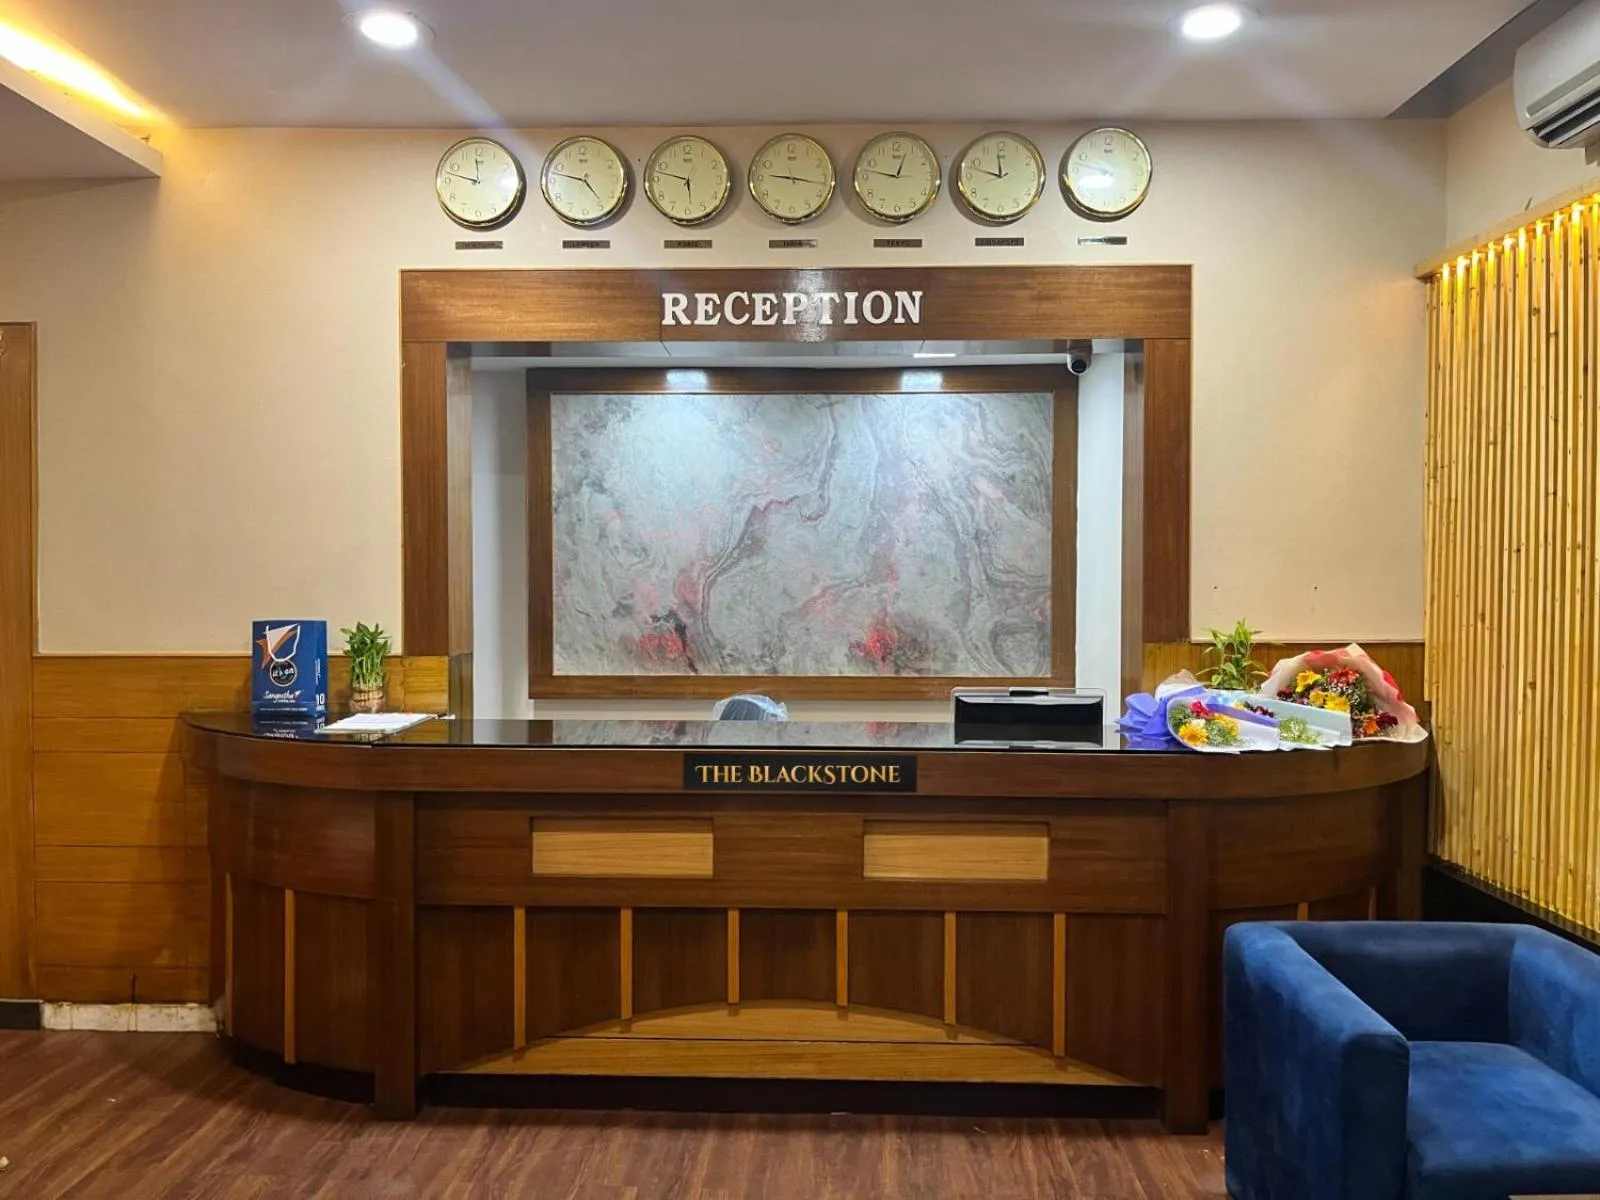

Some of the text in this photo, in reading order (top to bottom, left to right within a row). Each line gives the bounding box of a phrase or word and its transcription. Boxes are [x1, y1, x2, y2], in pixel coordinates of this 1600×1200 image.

[1105, 136, 1113, 145] 12
[578, 145, 587, 155] 12
[683, 145, 692, 155] 12
[787, 144, 795, 153] 12
[893, 142, 901, 151] 12
[997, 141, 1005, 151] 12
[475, 147, 483, 156] 12
[661, 290, 923, 326] RECEPTION
[316, 693, 325, 705] 10
[695, 764, 901, 785] THE BLACKSTONE
